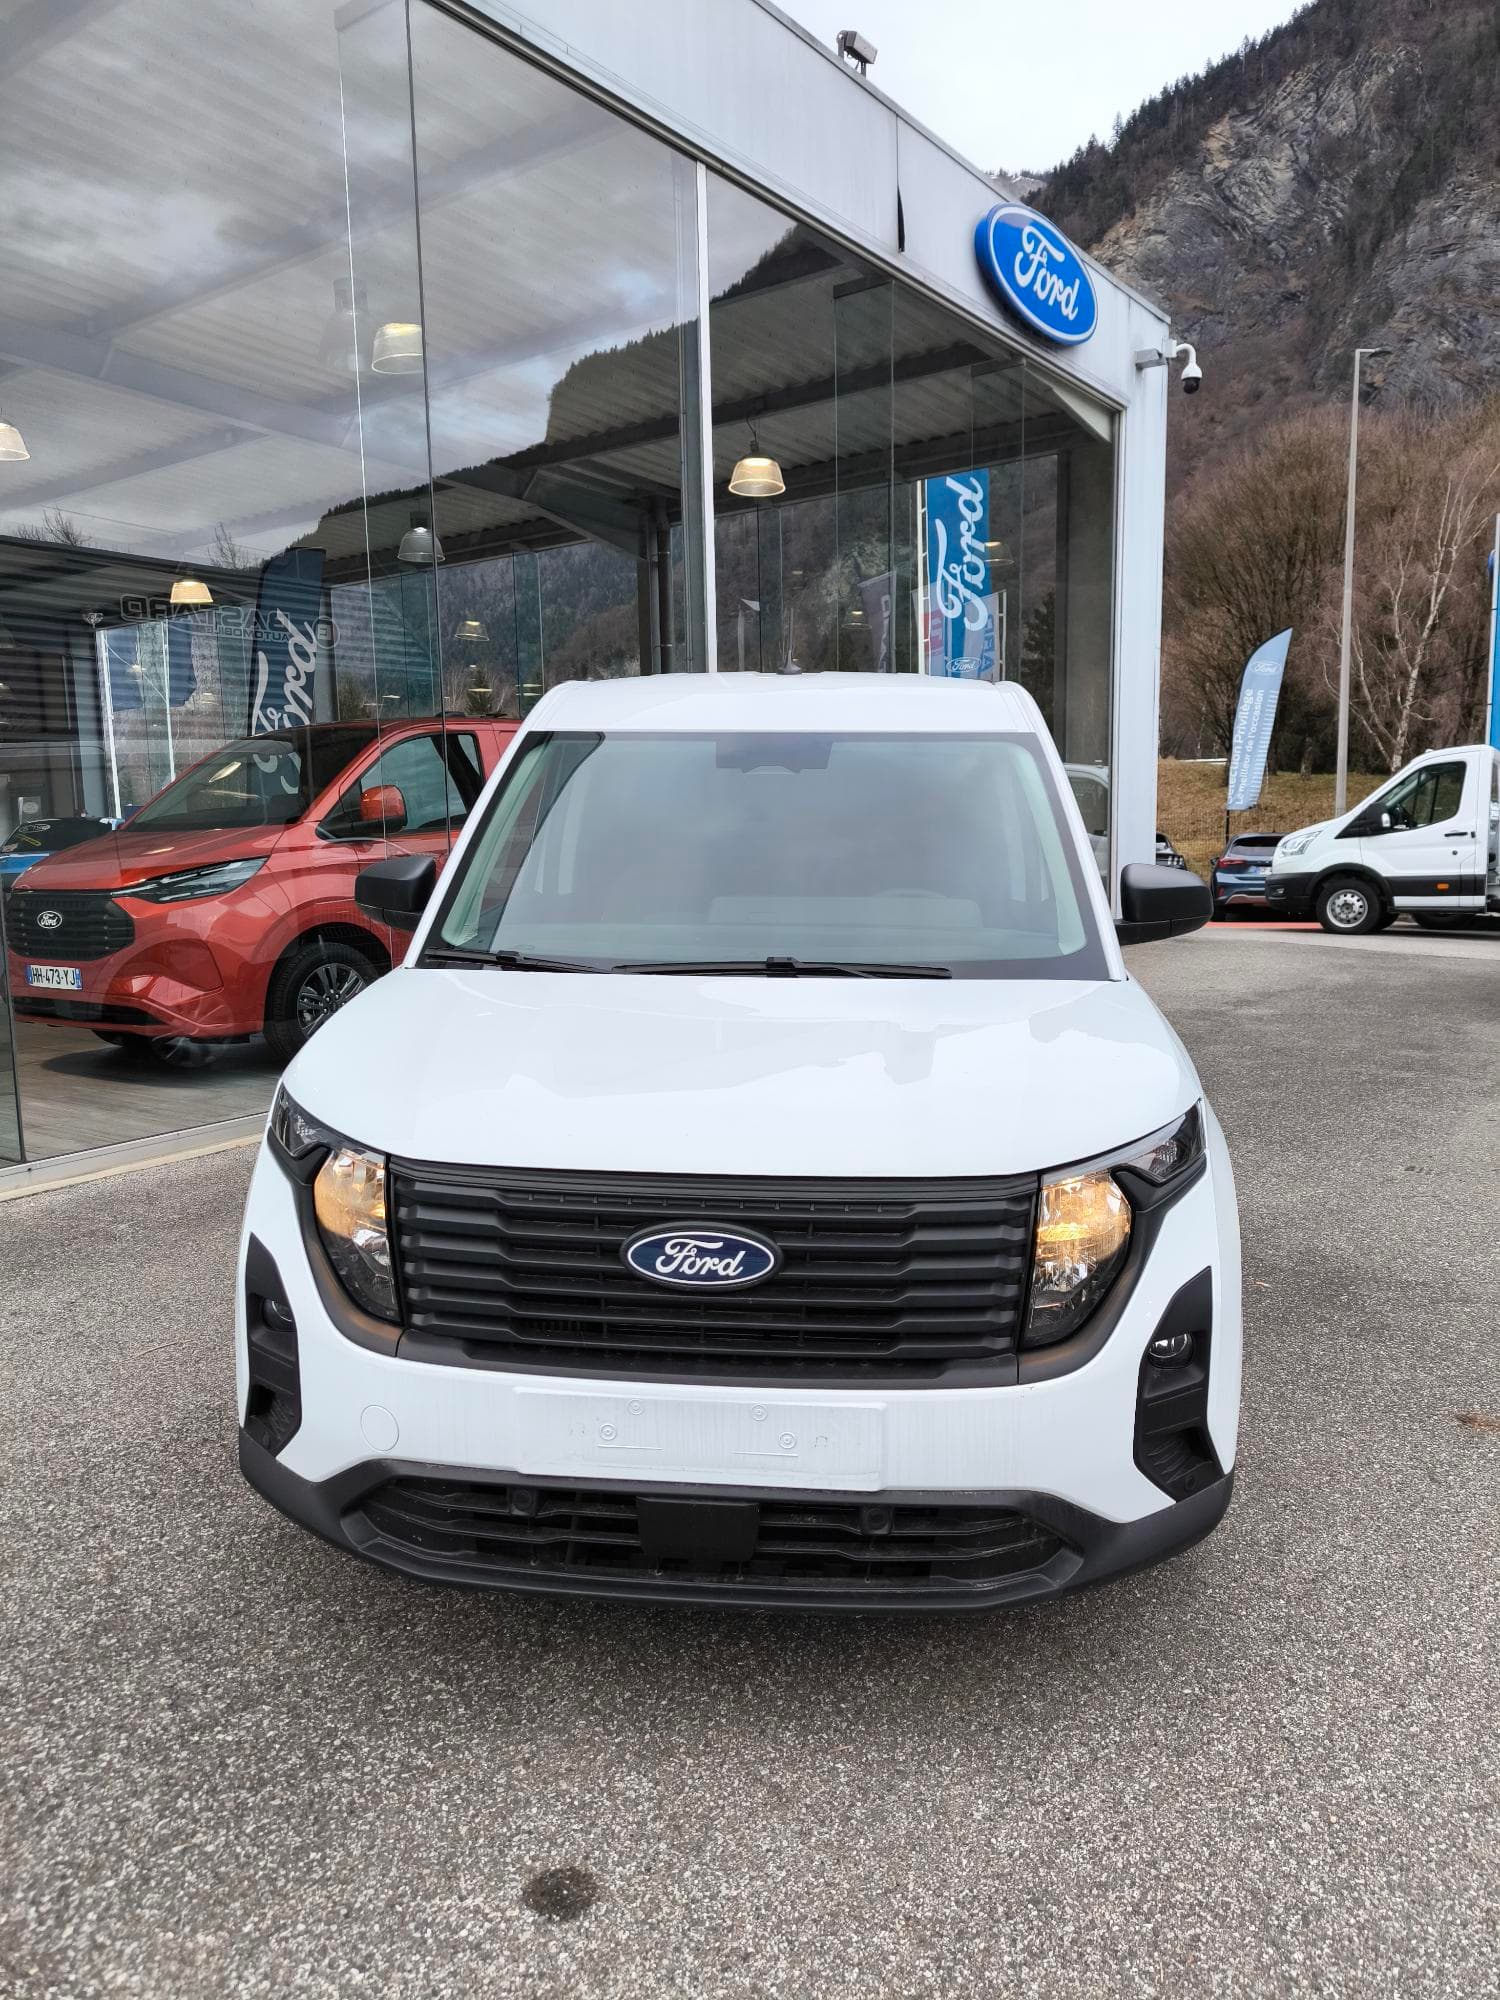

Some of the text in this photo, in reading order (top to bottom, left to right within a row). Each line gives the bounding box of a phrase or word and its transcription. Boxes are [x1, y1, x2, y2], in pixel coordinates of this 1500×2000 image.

[1014, 225, 1080, 321] Ford
[935, 476, 987, 632] Ford
[1245, 740, 1254, 752] de
[32, 968, 75, 985] HH-473-YJ
[656, 1239, 745, 1276] Ford
